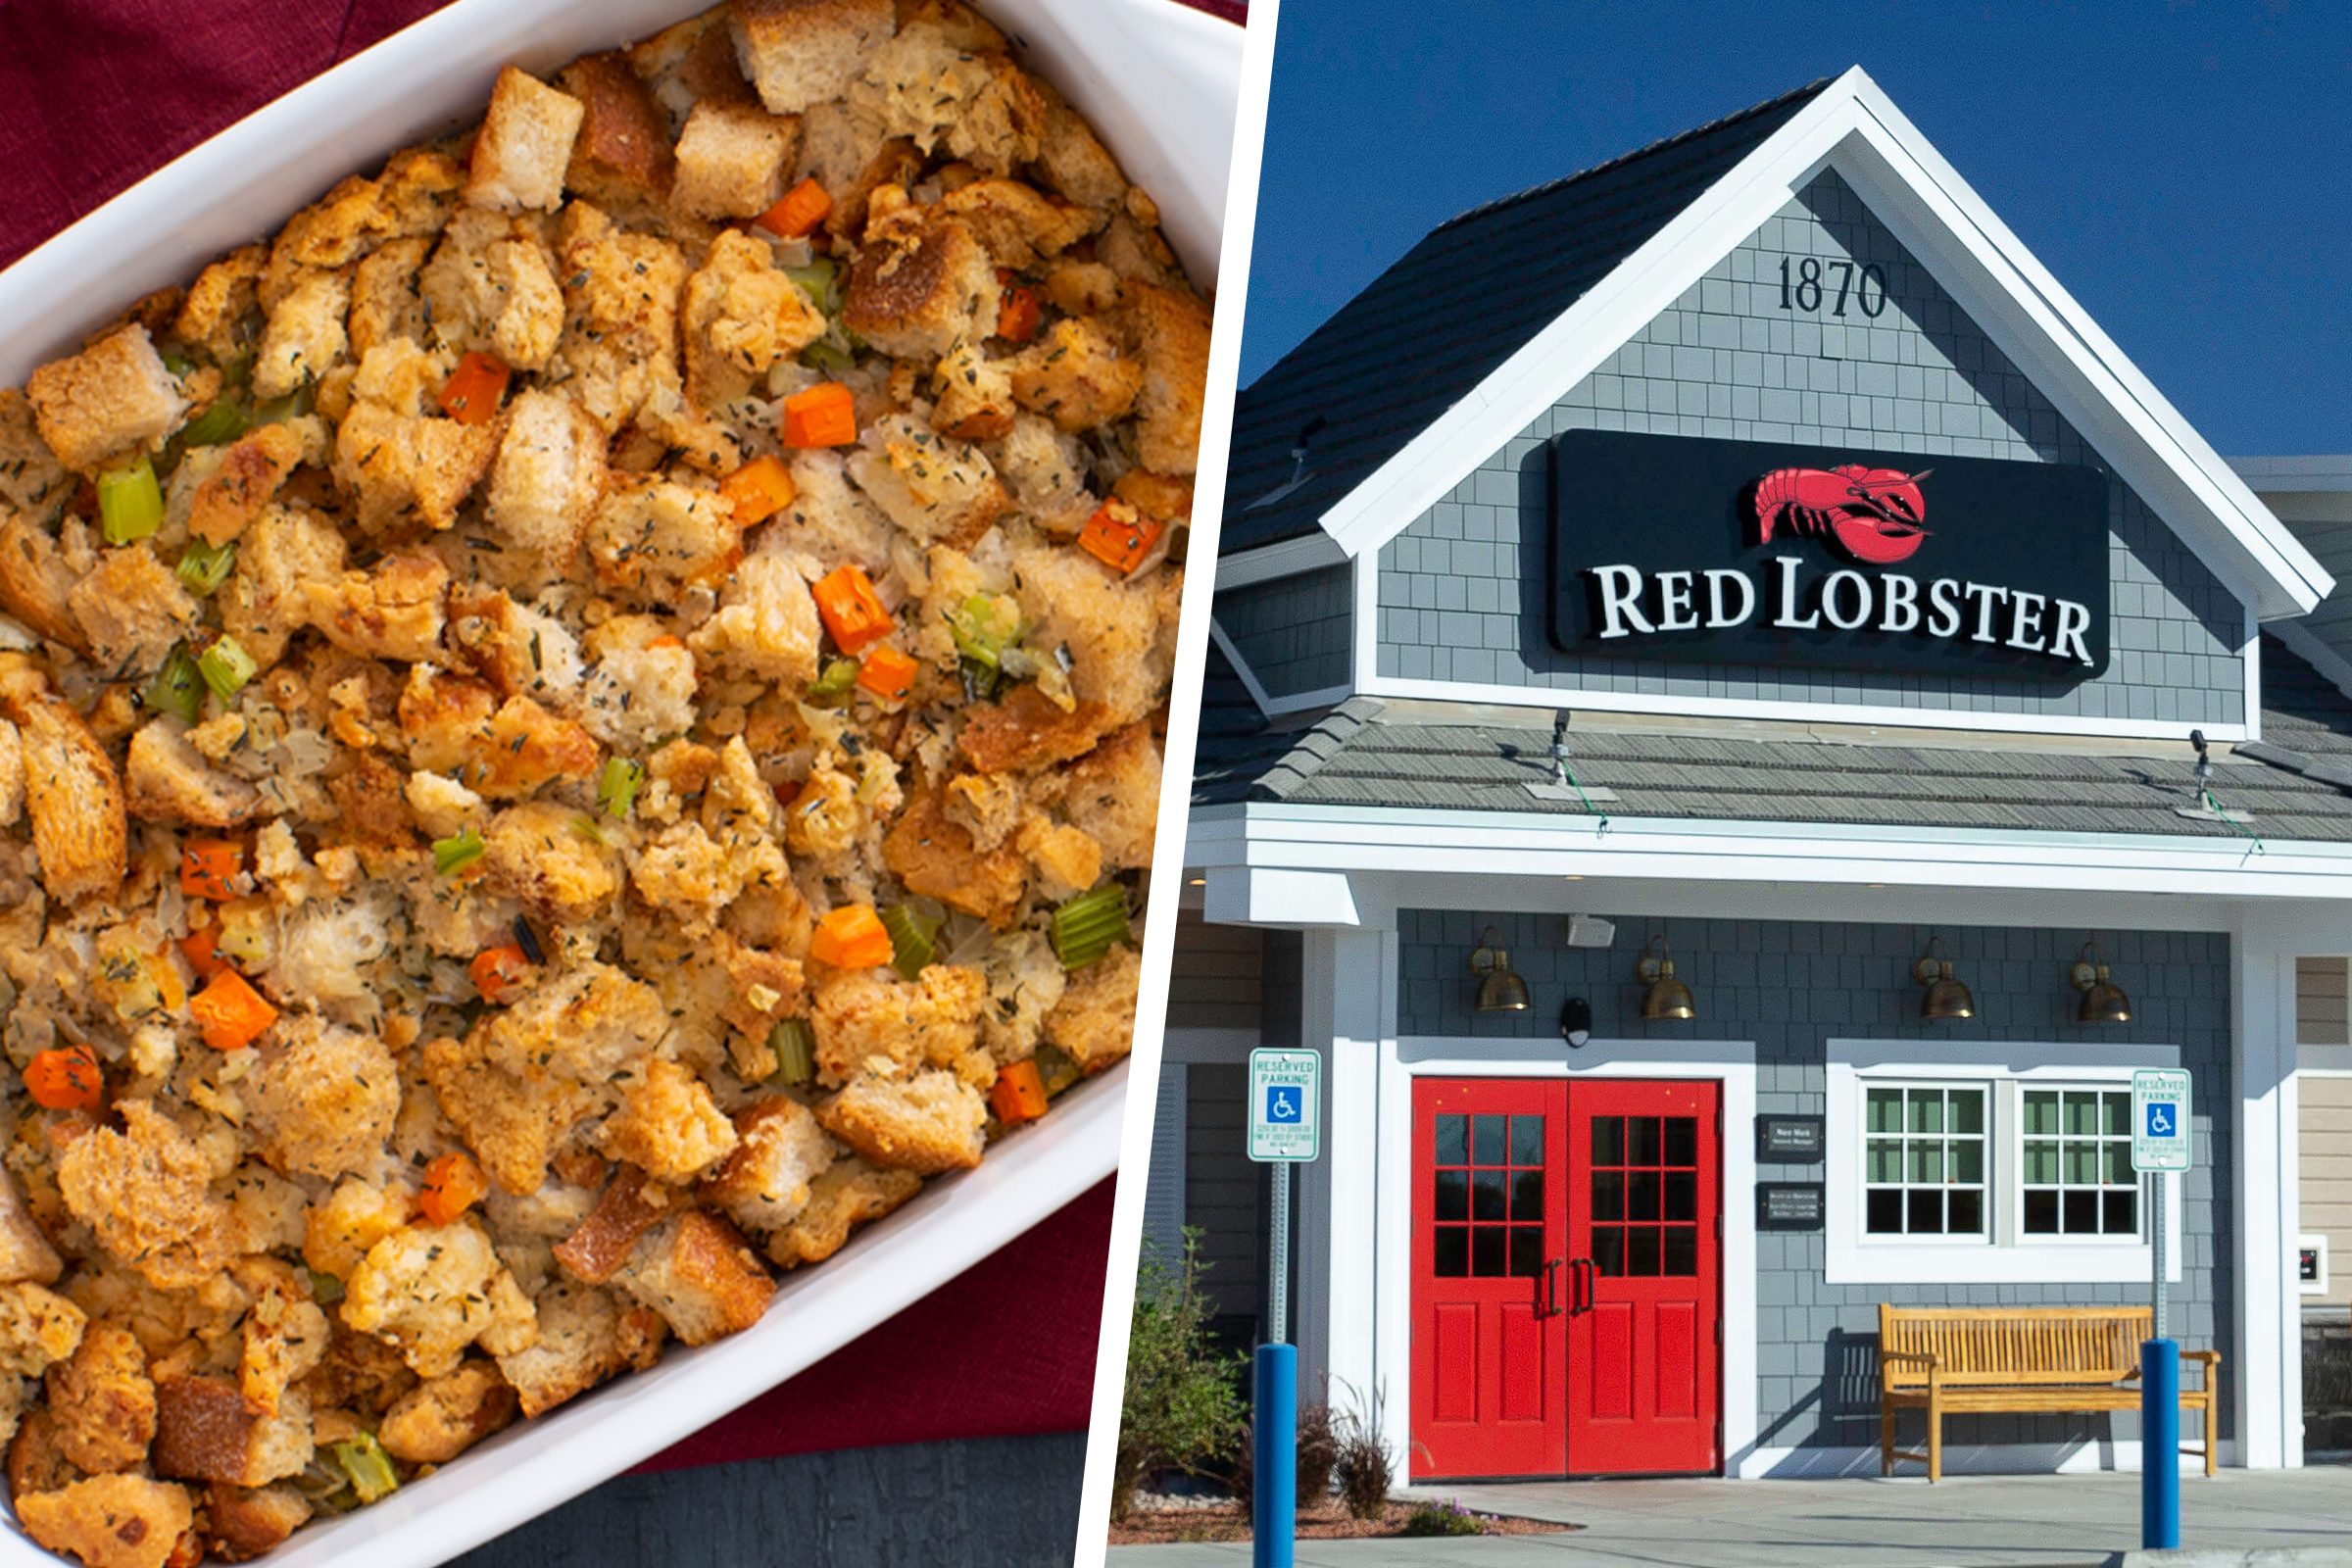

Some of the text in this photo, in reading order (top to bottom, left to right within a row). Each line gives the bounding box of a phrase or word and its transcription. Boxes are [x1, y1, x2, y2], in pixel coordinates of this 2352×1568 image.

[1778, 254, 1887, 318] 1870
[1592, 555, 2095, 667] RED LOBSTER
[1256, 1060, 1314, 1073] RESERVED
[1260, 1073, 1309, 1085] PARKING
[2137, 1080, 2185, 1091] RESERVED
[2141, 1092, 2181, 1102] PARKING
